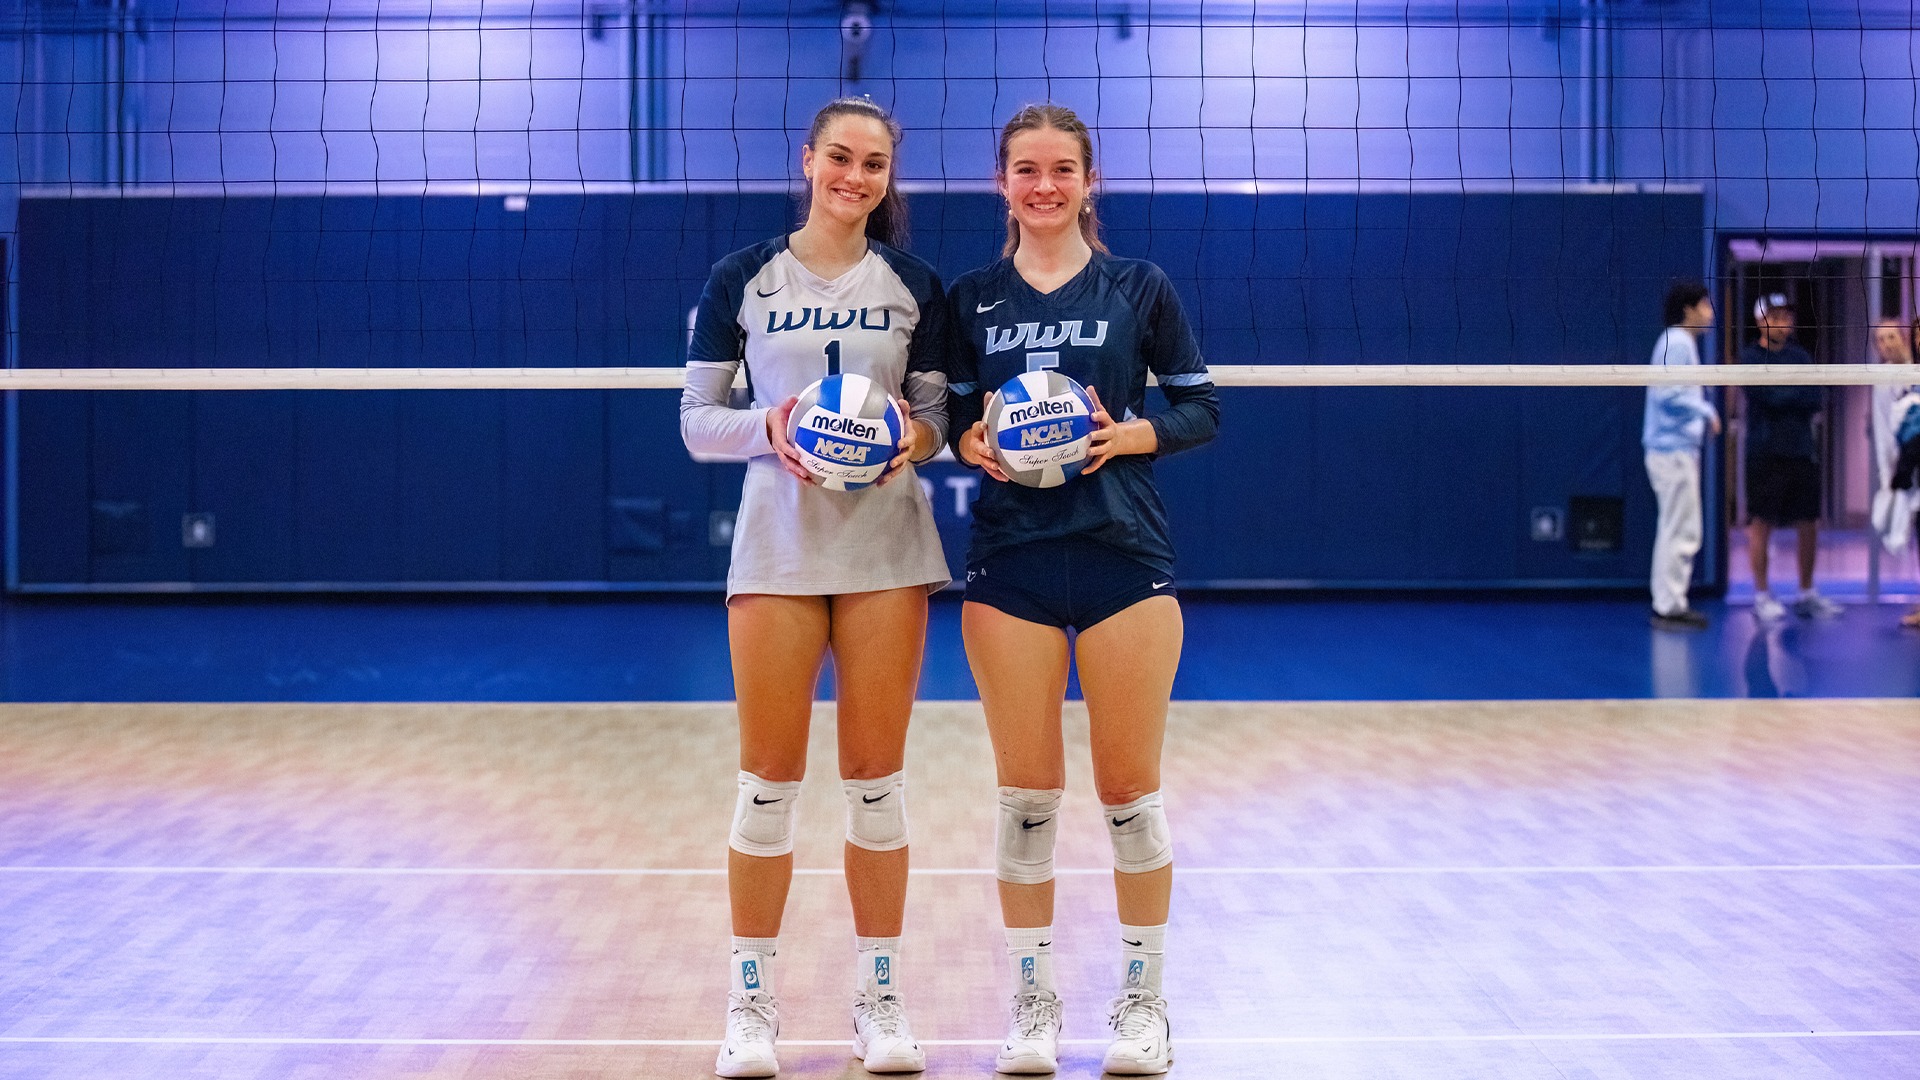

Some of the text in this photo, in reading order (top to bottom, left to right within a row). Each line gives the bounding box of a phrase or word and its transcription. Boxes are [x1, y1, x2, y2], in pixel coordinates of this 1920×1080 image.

[766, 307, 891, 334] WWU
[985, 320, 1109, 355] WWU
[823, 339, 842, 376] 1
[1009, 401, 1074, 425] molten
[811, 415, 877, 440] molten
[1021, 421, 1072, 448] NCAA
[813, 437, 868, 464] NCAA
[1019, 445, 1079, 467] Super Touch
[806, 459, 868, 479] Super Touch
